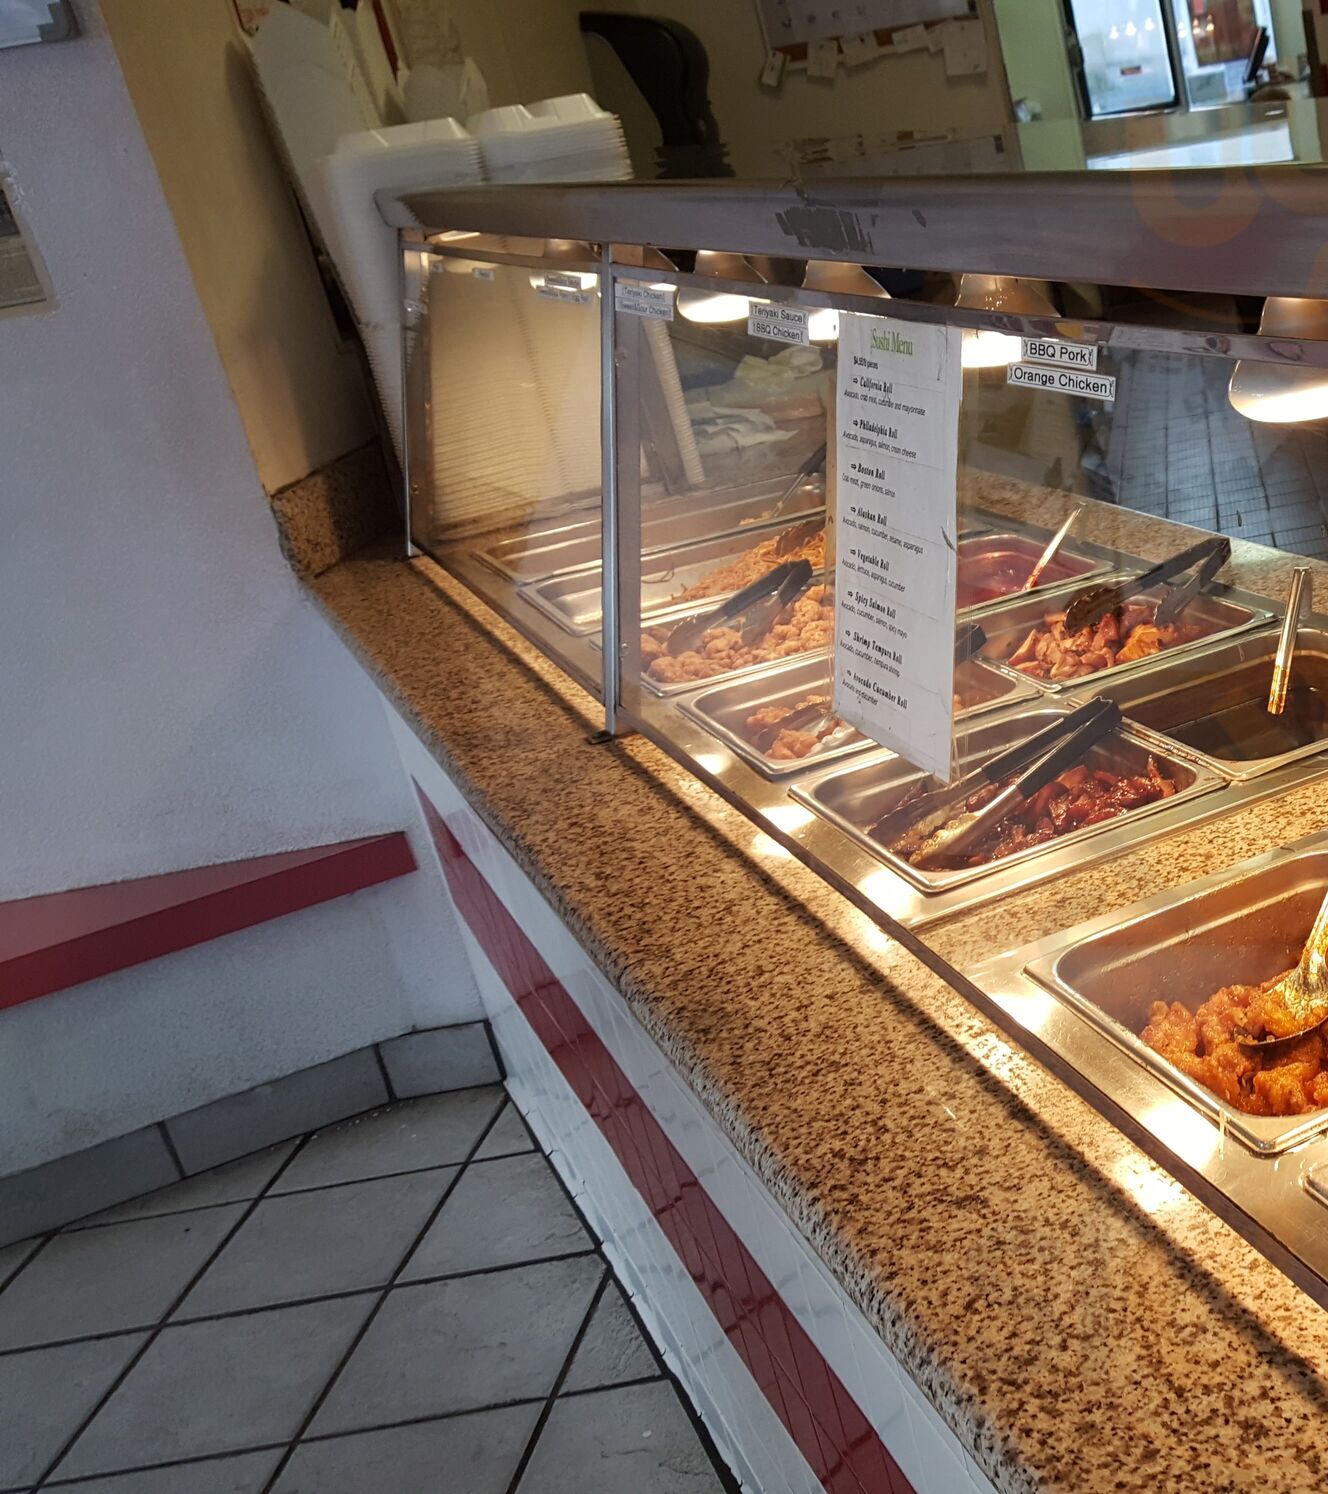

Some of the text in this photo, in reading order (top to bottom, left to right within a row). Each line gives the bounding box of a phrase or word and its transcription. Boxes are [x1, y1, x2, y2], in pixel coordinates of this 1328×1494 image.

[781, 310, 802, 322] Sauce
[756, 322, 800, 340] BBQ Chicken
[871, 328, 913, 355] Sushi Menu
[1029, 342, 1087, 363] BBQ Pork
[860, 376, 893, 394] California Roll
[1013, 367, 1107, 393] Orange Chicken
[859, 419, 898, 440] Philadelphia Roll
[858, 463, 885, 480] Boston Roll
[857, 507, 887, 527] Alaskan Roll
[857, 549, 890, 572] Vegetable Roll
[855, 591, 897, 619] Spicy Salmon Roll
[853, 631, 903, 665] Shrimp Tempura Roll
[853, 672, 908, 709] Avocado Cucumber Roll
